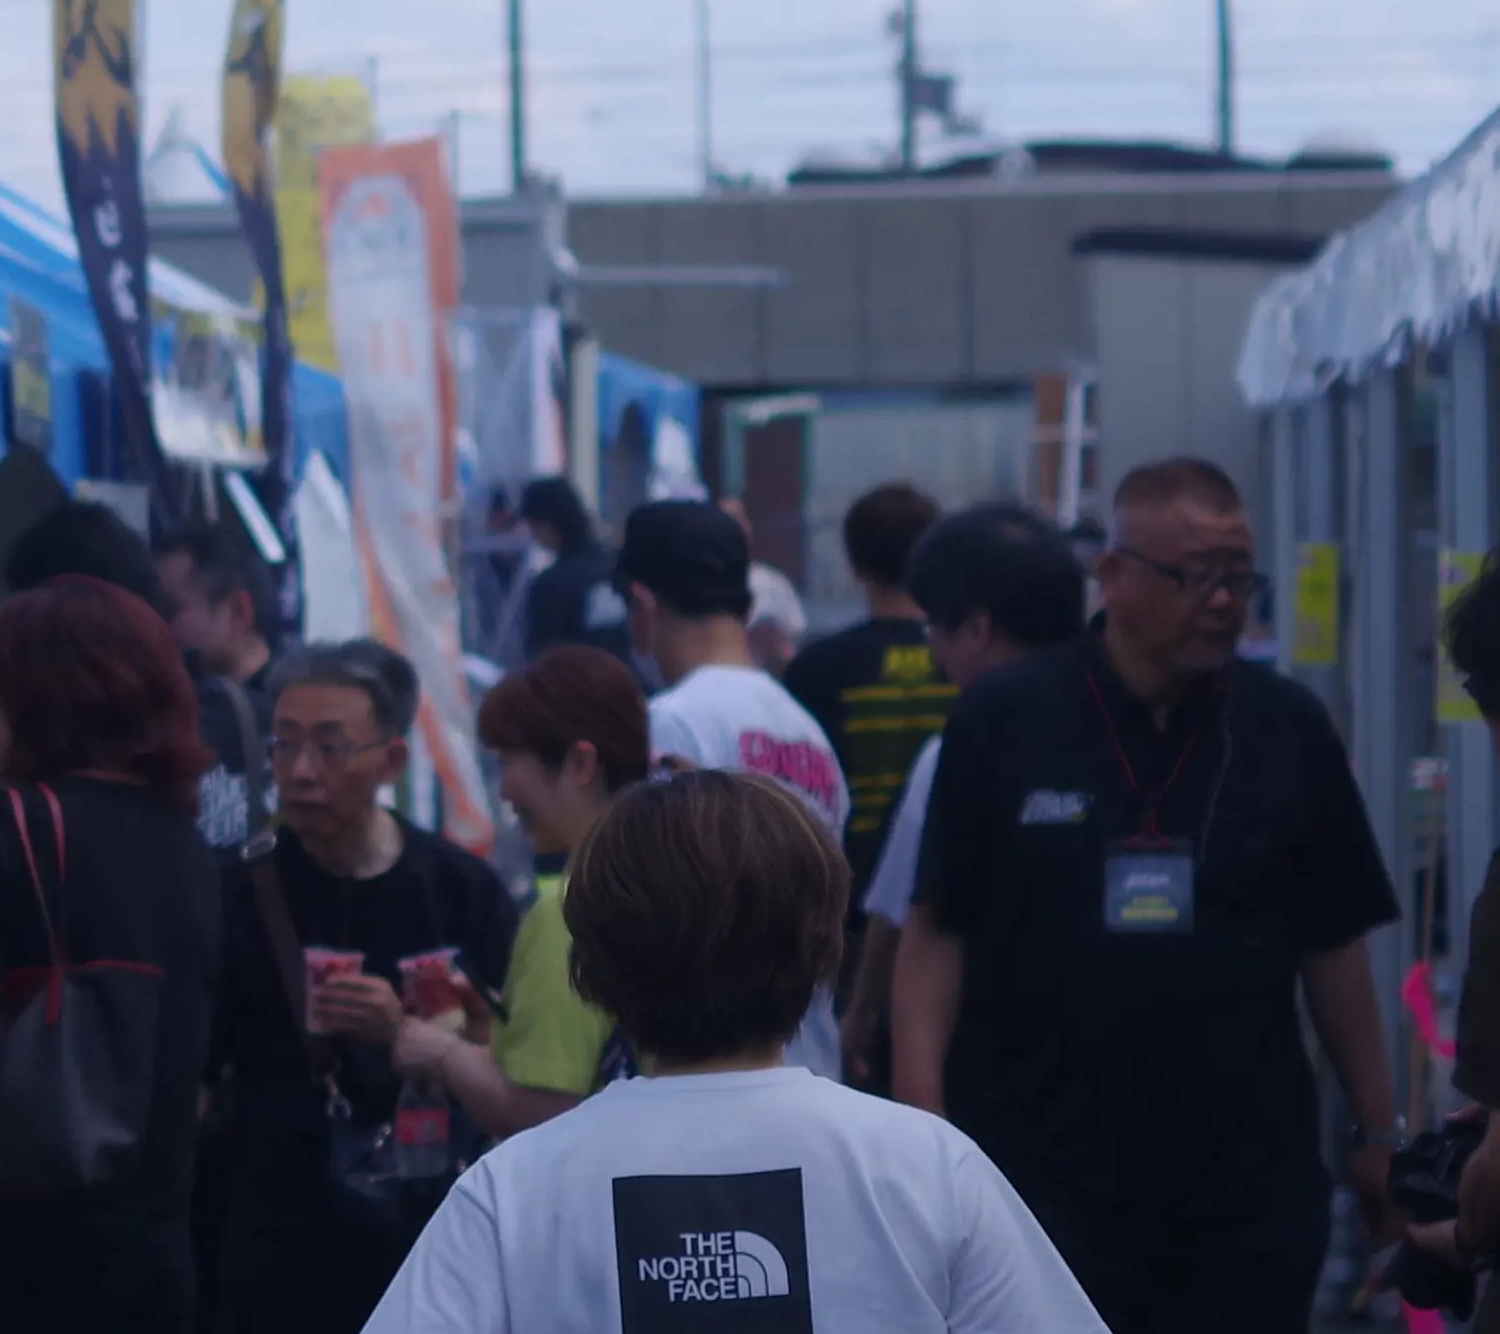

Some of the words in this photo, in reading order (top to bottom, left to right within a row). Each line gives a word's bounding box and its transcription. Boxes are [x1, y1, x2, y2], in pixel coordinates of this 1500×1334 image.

[680, 1231, 733, 1256] THE
[638, 1253, 736, 1282] NORTH
[668, 1277, 738, 1303] FACE
